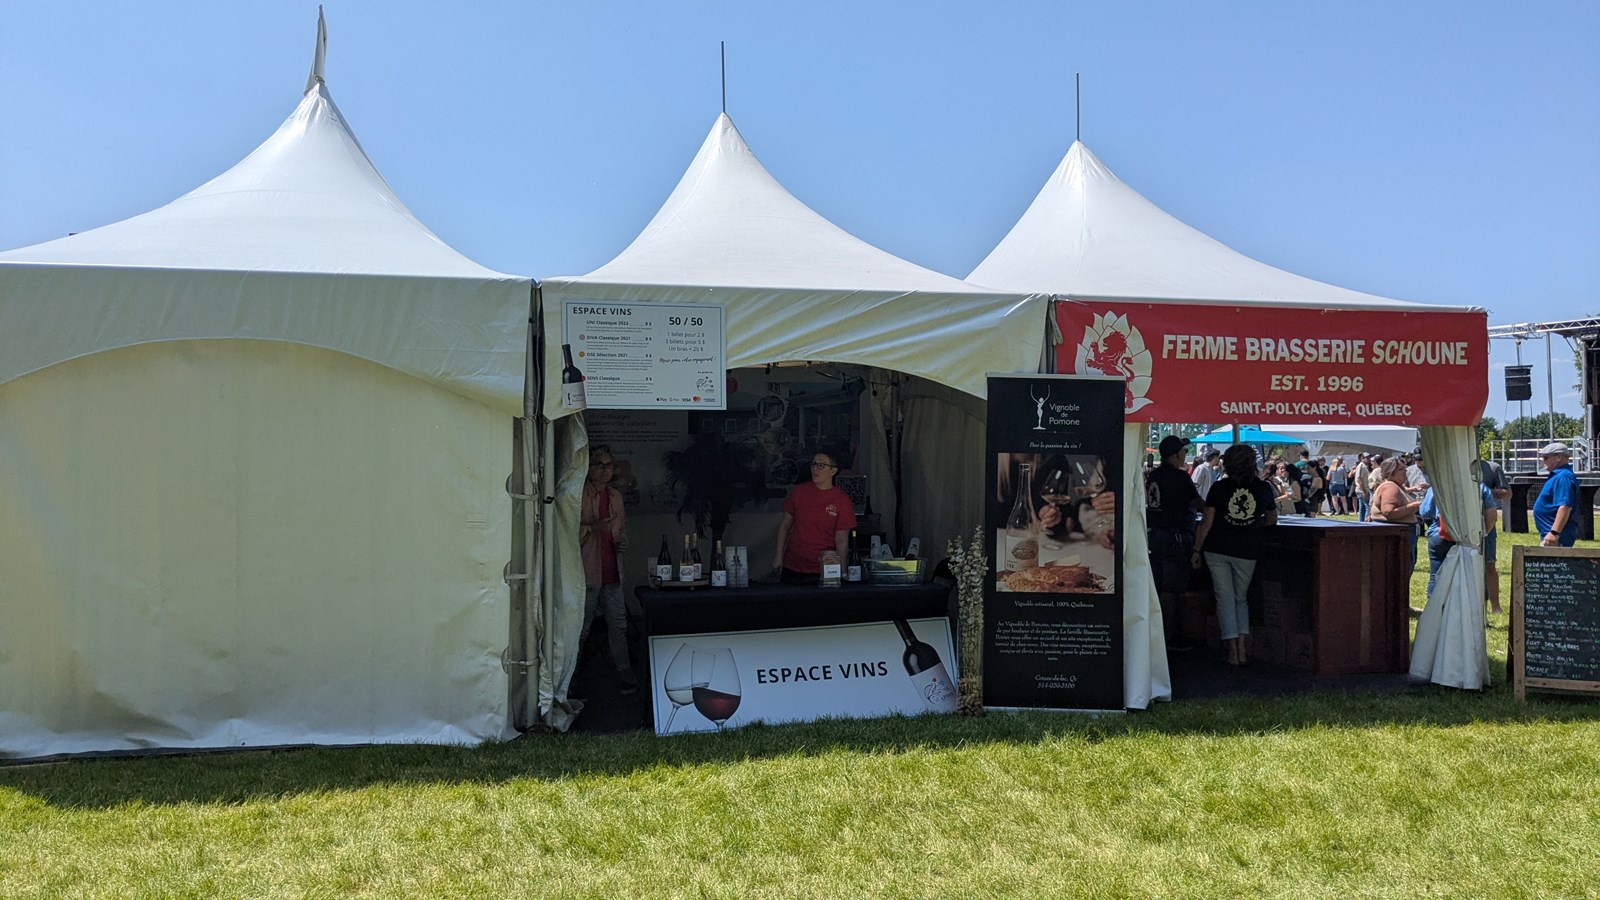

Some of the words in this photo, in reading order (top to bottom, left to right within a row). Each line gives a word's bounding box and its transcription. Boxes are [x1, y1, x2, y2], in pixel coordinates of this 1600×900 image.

[573, 307, 607, 315] ESPACE
[669, 317, 681, 326] 50
[683, 317, 688, 326] /
[690, 318, 703, 326] 50
[1162, 334, 1238, 360] FERME
[1245, 336, 1365, 364] BRASSERIE
[1372, 339, 1468, 365] SCHOUNE
[1270, 375, 1308, 391] EST.
[1317, 376, 1364, 392] 1996
[1220, 401, 1351, 416] SAINT-POLYCARPE,
[1355, 400, 1412, 416] QUÉBEC
[1049, 417, 1080, 425] Pomone
[757, 664, 832, 684] ESPACE
[838, 660, 888, 679] VINS
